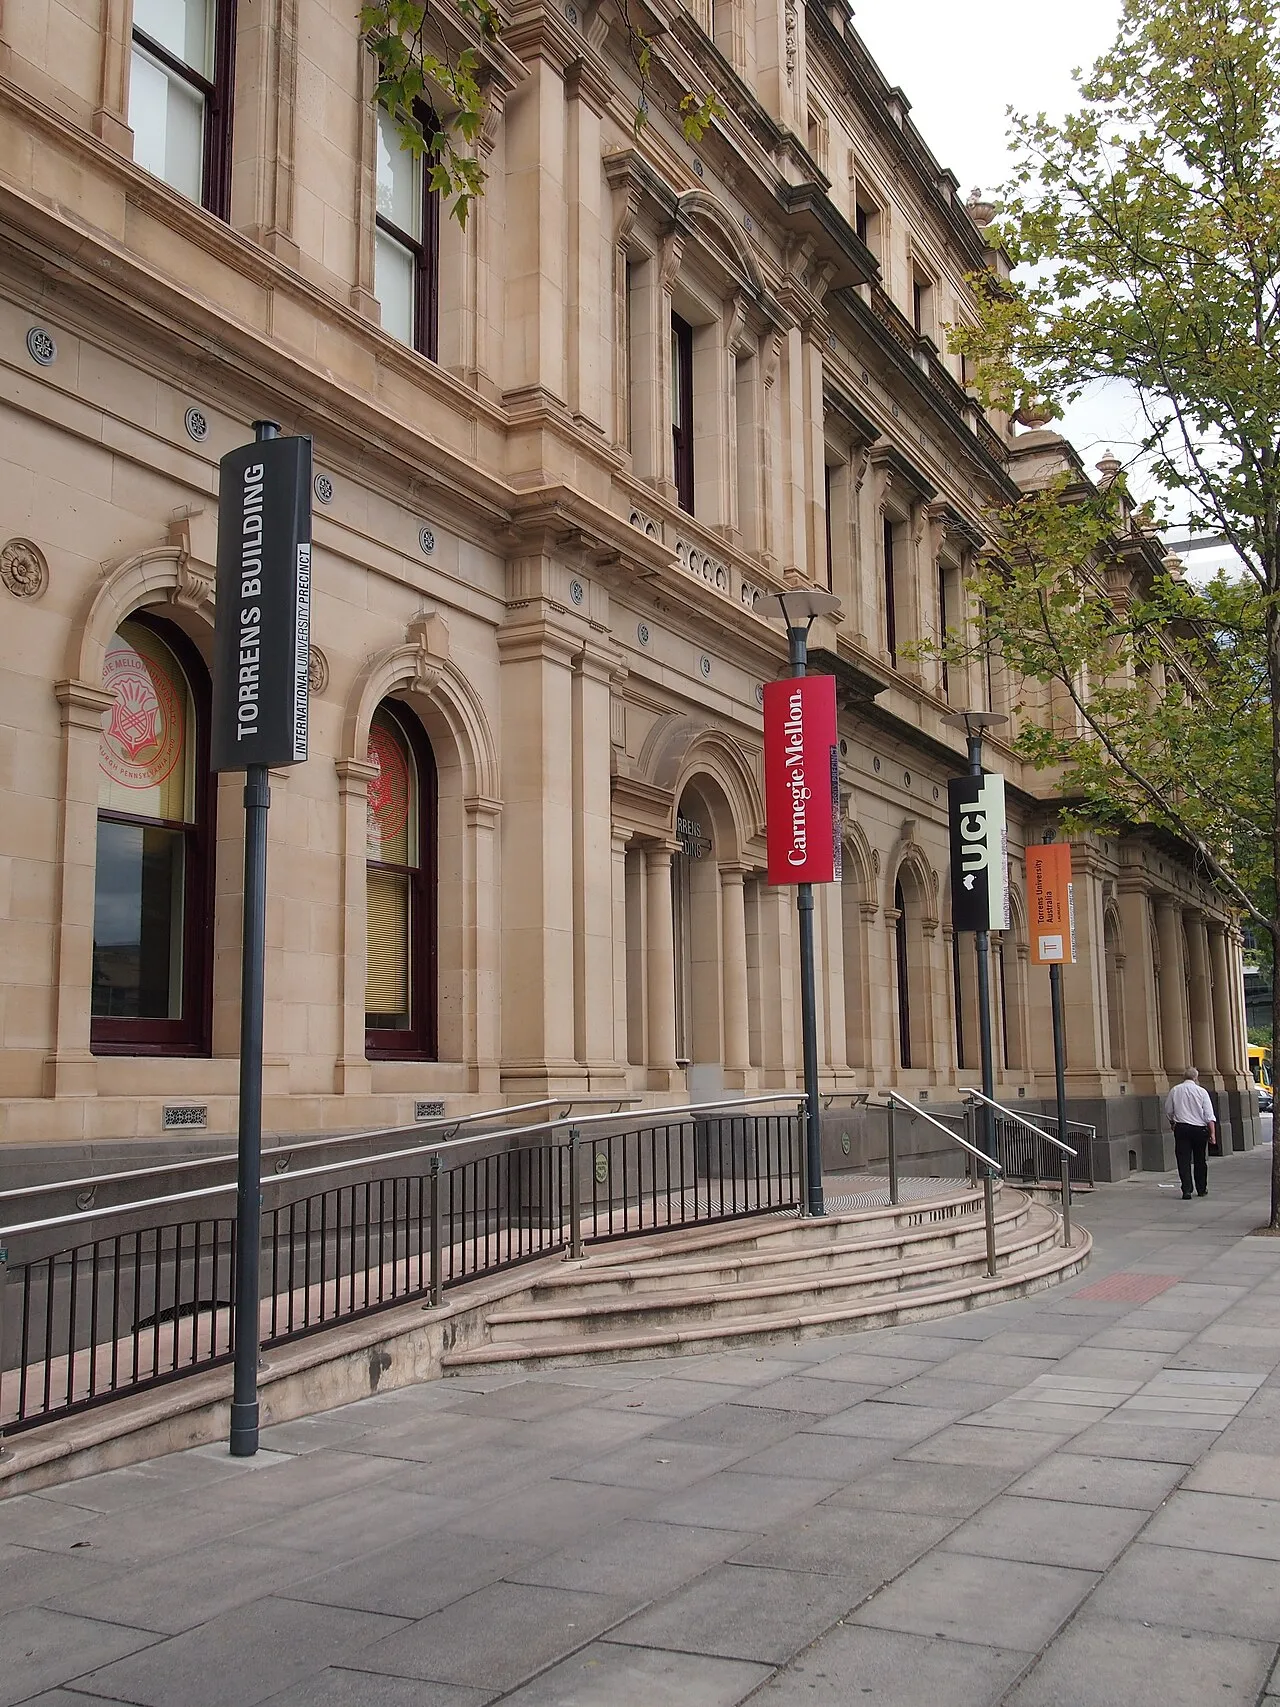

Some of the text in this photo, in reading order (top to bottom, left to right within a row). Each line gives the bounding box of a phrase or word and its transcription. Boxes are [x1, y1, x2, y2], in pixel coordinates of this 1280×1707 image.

[238, 462, 265, 741] TORRENS BUILDING
[115, 658, 147, 673] MELLON
[295, 550, 311, 755] INTERNATIONAL UNIVERSITY PRECINCT
[120, 758, 168, 779] PENNSYLVANIA
[830, 746, 839, 782] PRECINCT
[678, 817, 701, 838] RRENS
[786, 768, 812, 866] Carnegie
[959, 790, 988, 872] UCL
[1035, 859, 1045, 924] Torrens University
[1045, 891, 1054, 923] Australia
